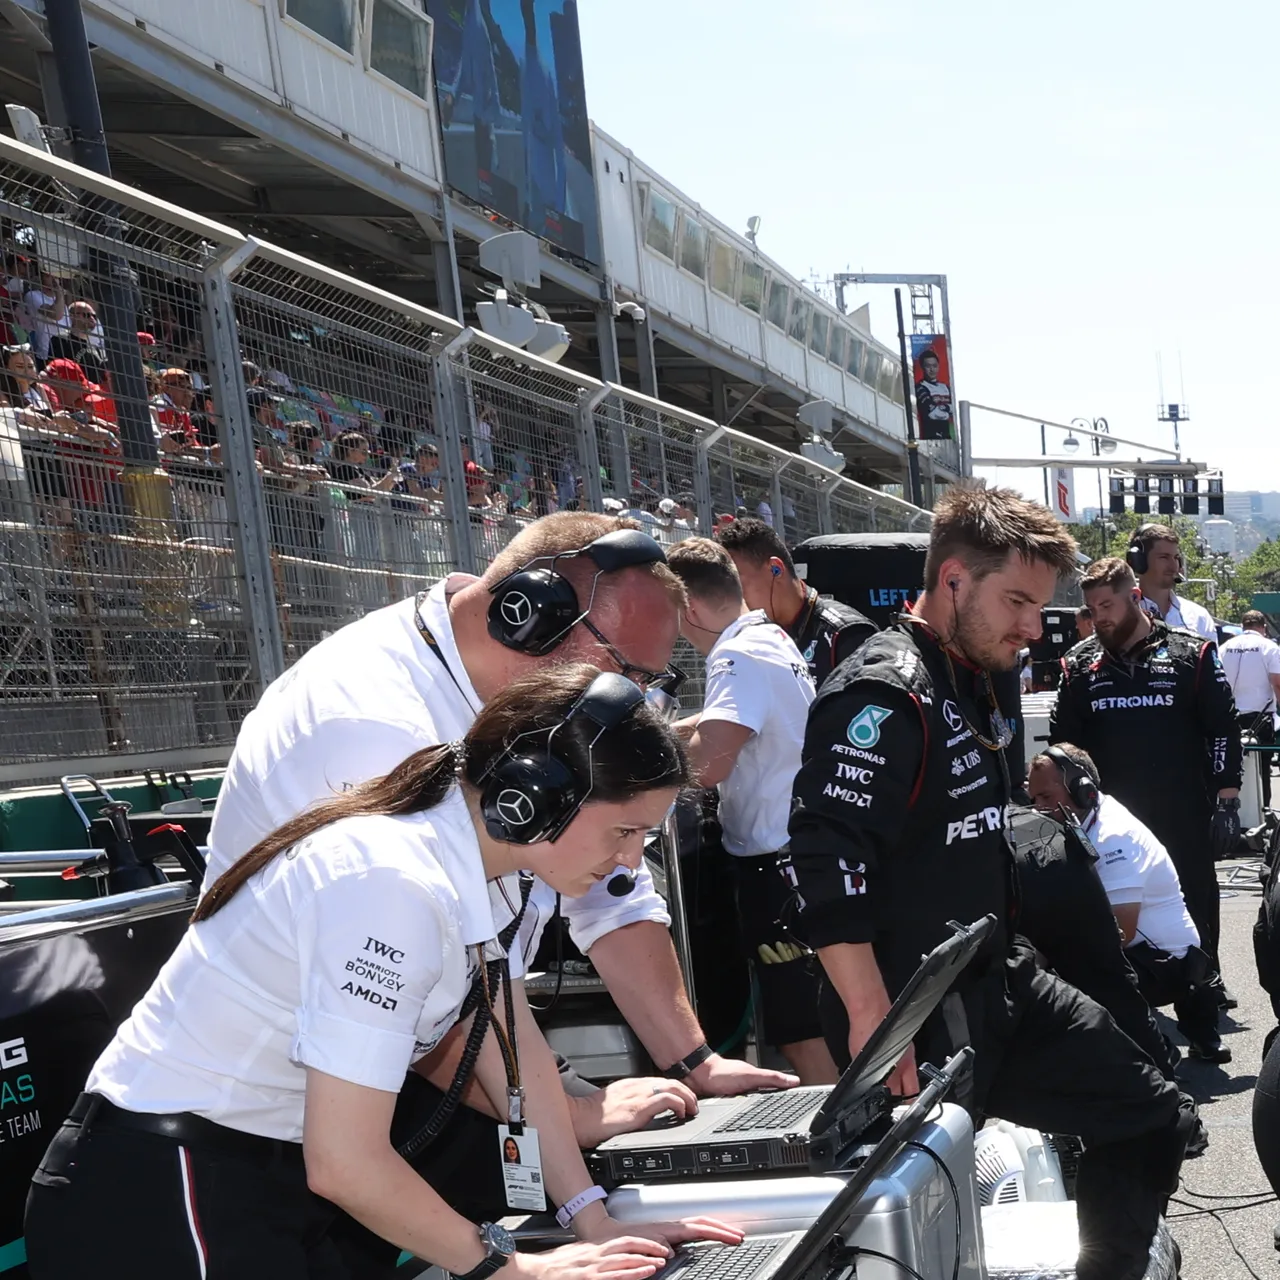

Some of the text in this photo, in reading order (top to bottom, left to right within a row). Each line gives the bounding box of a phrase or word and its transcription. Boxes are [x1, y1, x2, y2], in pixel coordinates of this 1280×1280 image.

[869, 589, 909, 607] LEFT
[1091, 694, 1174, 712] PETRONAS
[831, 744, 887, 766] PETRONAS
[962, 749, 982, 769] UBS
[835, 762, 874, 785] IWC
[822, 783, 866, 806] AMD
[363, 937, 405, 964] IWC
[345, 961, 406, 992] BONVOY
[356, 957, 402, 980] MARRIOTT
[341, 982, 391, 1009] AMD
[7, 1110, 42, 1139] TEAM
